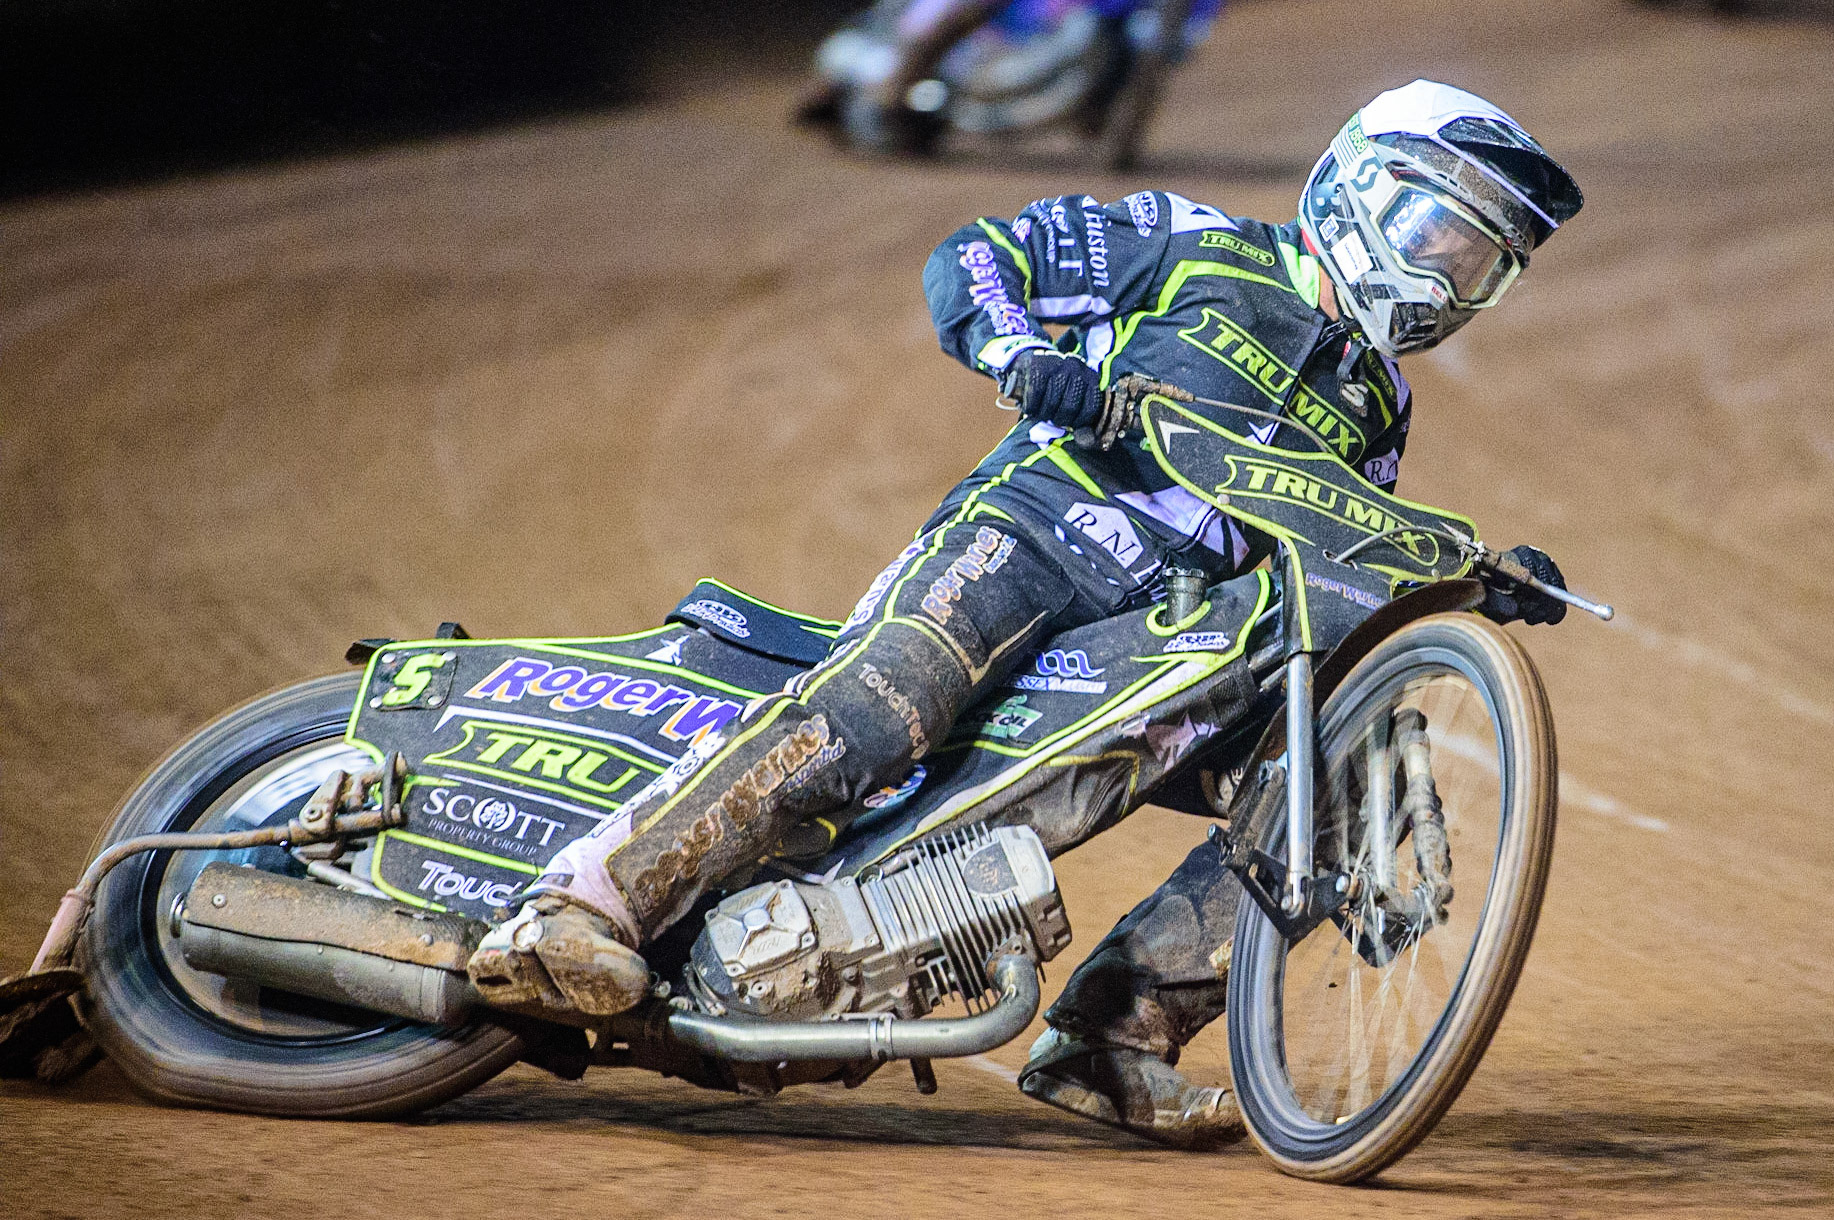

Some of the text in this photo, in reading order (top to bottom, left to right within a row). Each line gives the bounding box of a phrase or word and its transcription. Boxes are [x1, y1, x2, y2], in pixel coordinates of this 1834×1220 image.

[1349, 127, 1369, 154] 1958
[1210, 235, 1269, 263] TRU MIX
[1211, 323, 1360, 458] TRU MIX
[1245, 464, 1425, 556] TRU MIX
[382, 653, 447, 705] 5
[477, 732, 640, 793] TRU
[422, 787, 566, 847] SCOTT
[428, 818, 538, 857] PROPERTY GROUP
